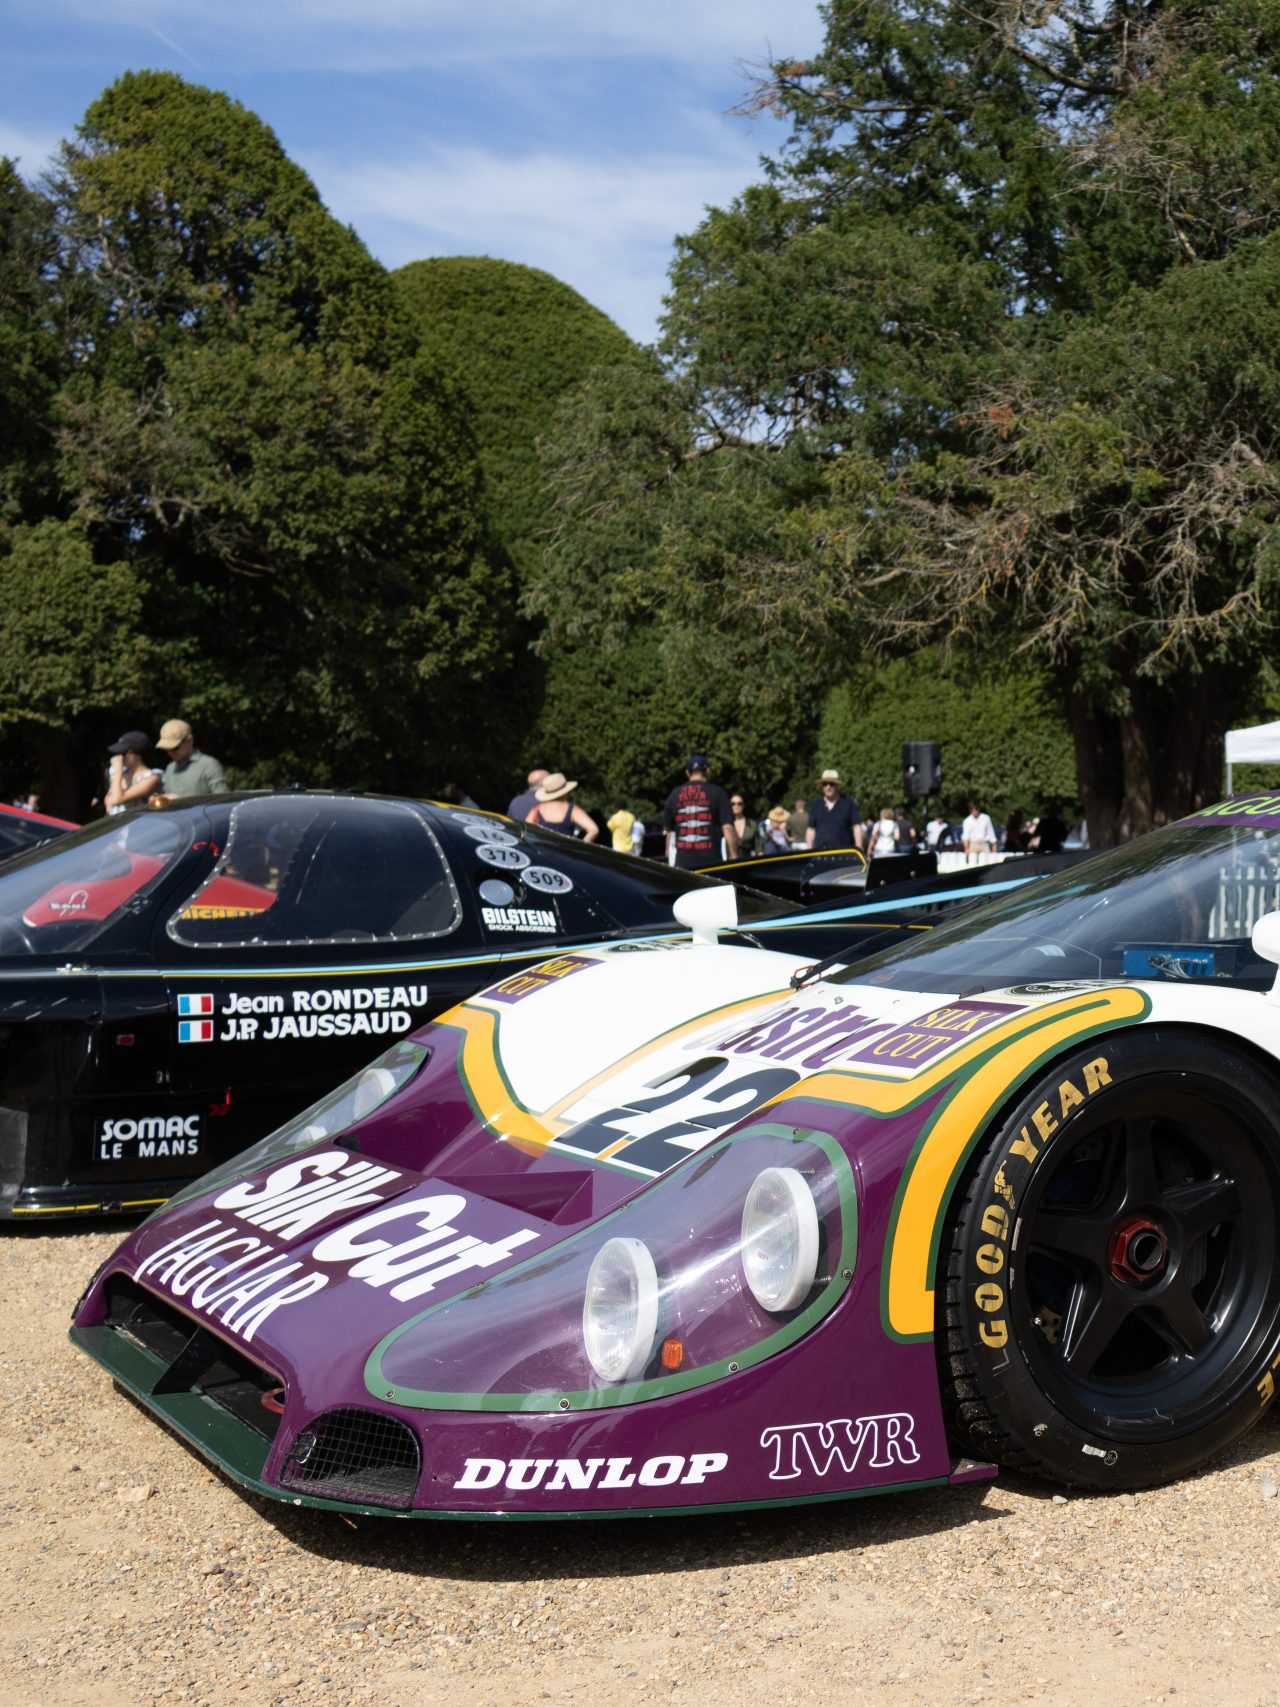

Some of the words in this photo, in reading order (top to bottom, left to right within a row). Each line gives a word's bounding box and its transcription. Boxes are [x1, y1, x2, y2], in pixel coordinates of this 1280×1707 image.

[484, 847, 521, 863] 379
[529, 871, 564, 887] 509
[481, 907, 557, 927] BILSTEIN
[488, 924, 514, 932] SHOCK
[497, 975, 550, 996] CUT
[221, 992, 284, 1016] Jean
[292, 985, 428, 1014] RONDEAU
[263, 1010, 412, 1040] JAUSSAUD
[912, 1007, 999, 1033] SILK
[872, 1031, 953, 1060] CUT
[553, 1056, 802, 1171] 22
[100, 1115, 200, 1142] SOMAC
[100, 1142, 123, 1160] LE
[138, 1139, 199, 1159] MANS
[213, 1151, 403, 1241] Silk
[311, 1194, 542, 1303] Cut
[132, 1218, 330, 1343] JAGUAR
[759, 1411, 922, 1480] TWR
[453, 1452, 729, 1491] DUNLOP
